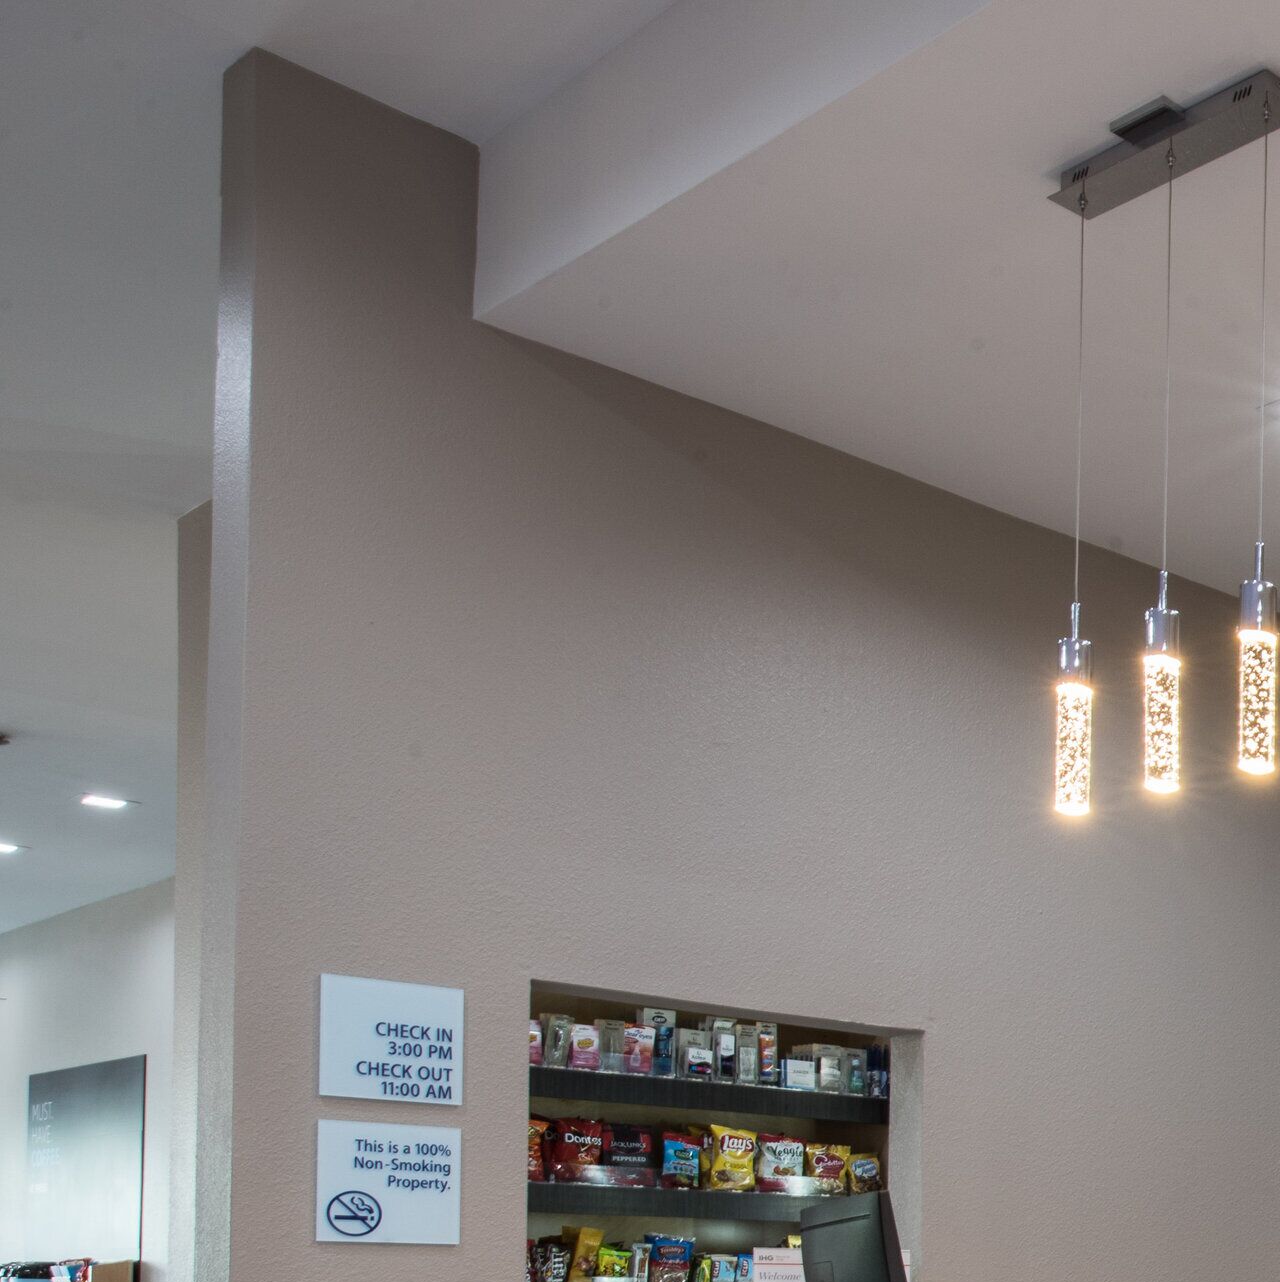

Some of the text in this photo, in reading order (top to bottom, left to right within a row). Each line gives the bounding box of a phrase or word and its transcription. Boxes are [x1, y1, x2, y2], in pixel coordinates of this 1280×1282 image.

[375, 1021, 453, 1043] CHECK IN
[388, 1041, 453, 1060] 3:00 PM
[356, 1060, 453, 1082] CHECK OUT
[381, 1081, 452, 1100] 11:00 AM
[355, 1139, 452, 1157] This is a 100%
[564, 1132, 602, 1146] Doritos
[723, 1135, 753, 1151] Lay's
[612, 1154, 647, 1163] PEPPERED
[766, 1145, 803, 1158] Veggie
[353, 1156, 451, 1177] Non-Smoking
[387, 1175, 451, 1193] Property.
[758, 1271, 802, 1281] Welcome
